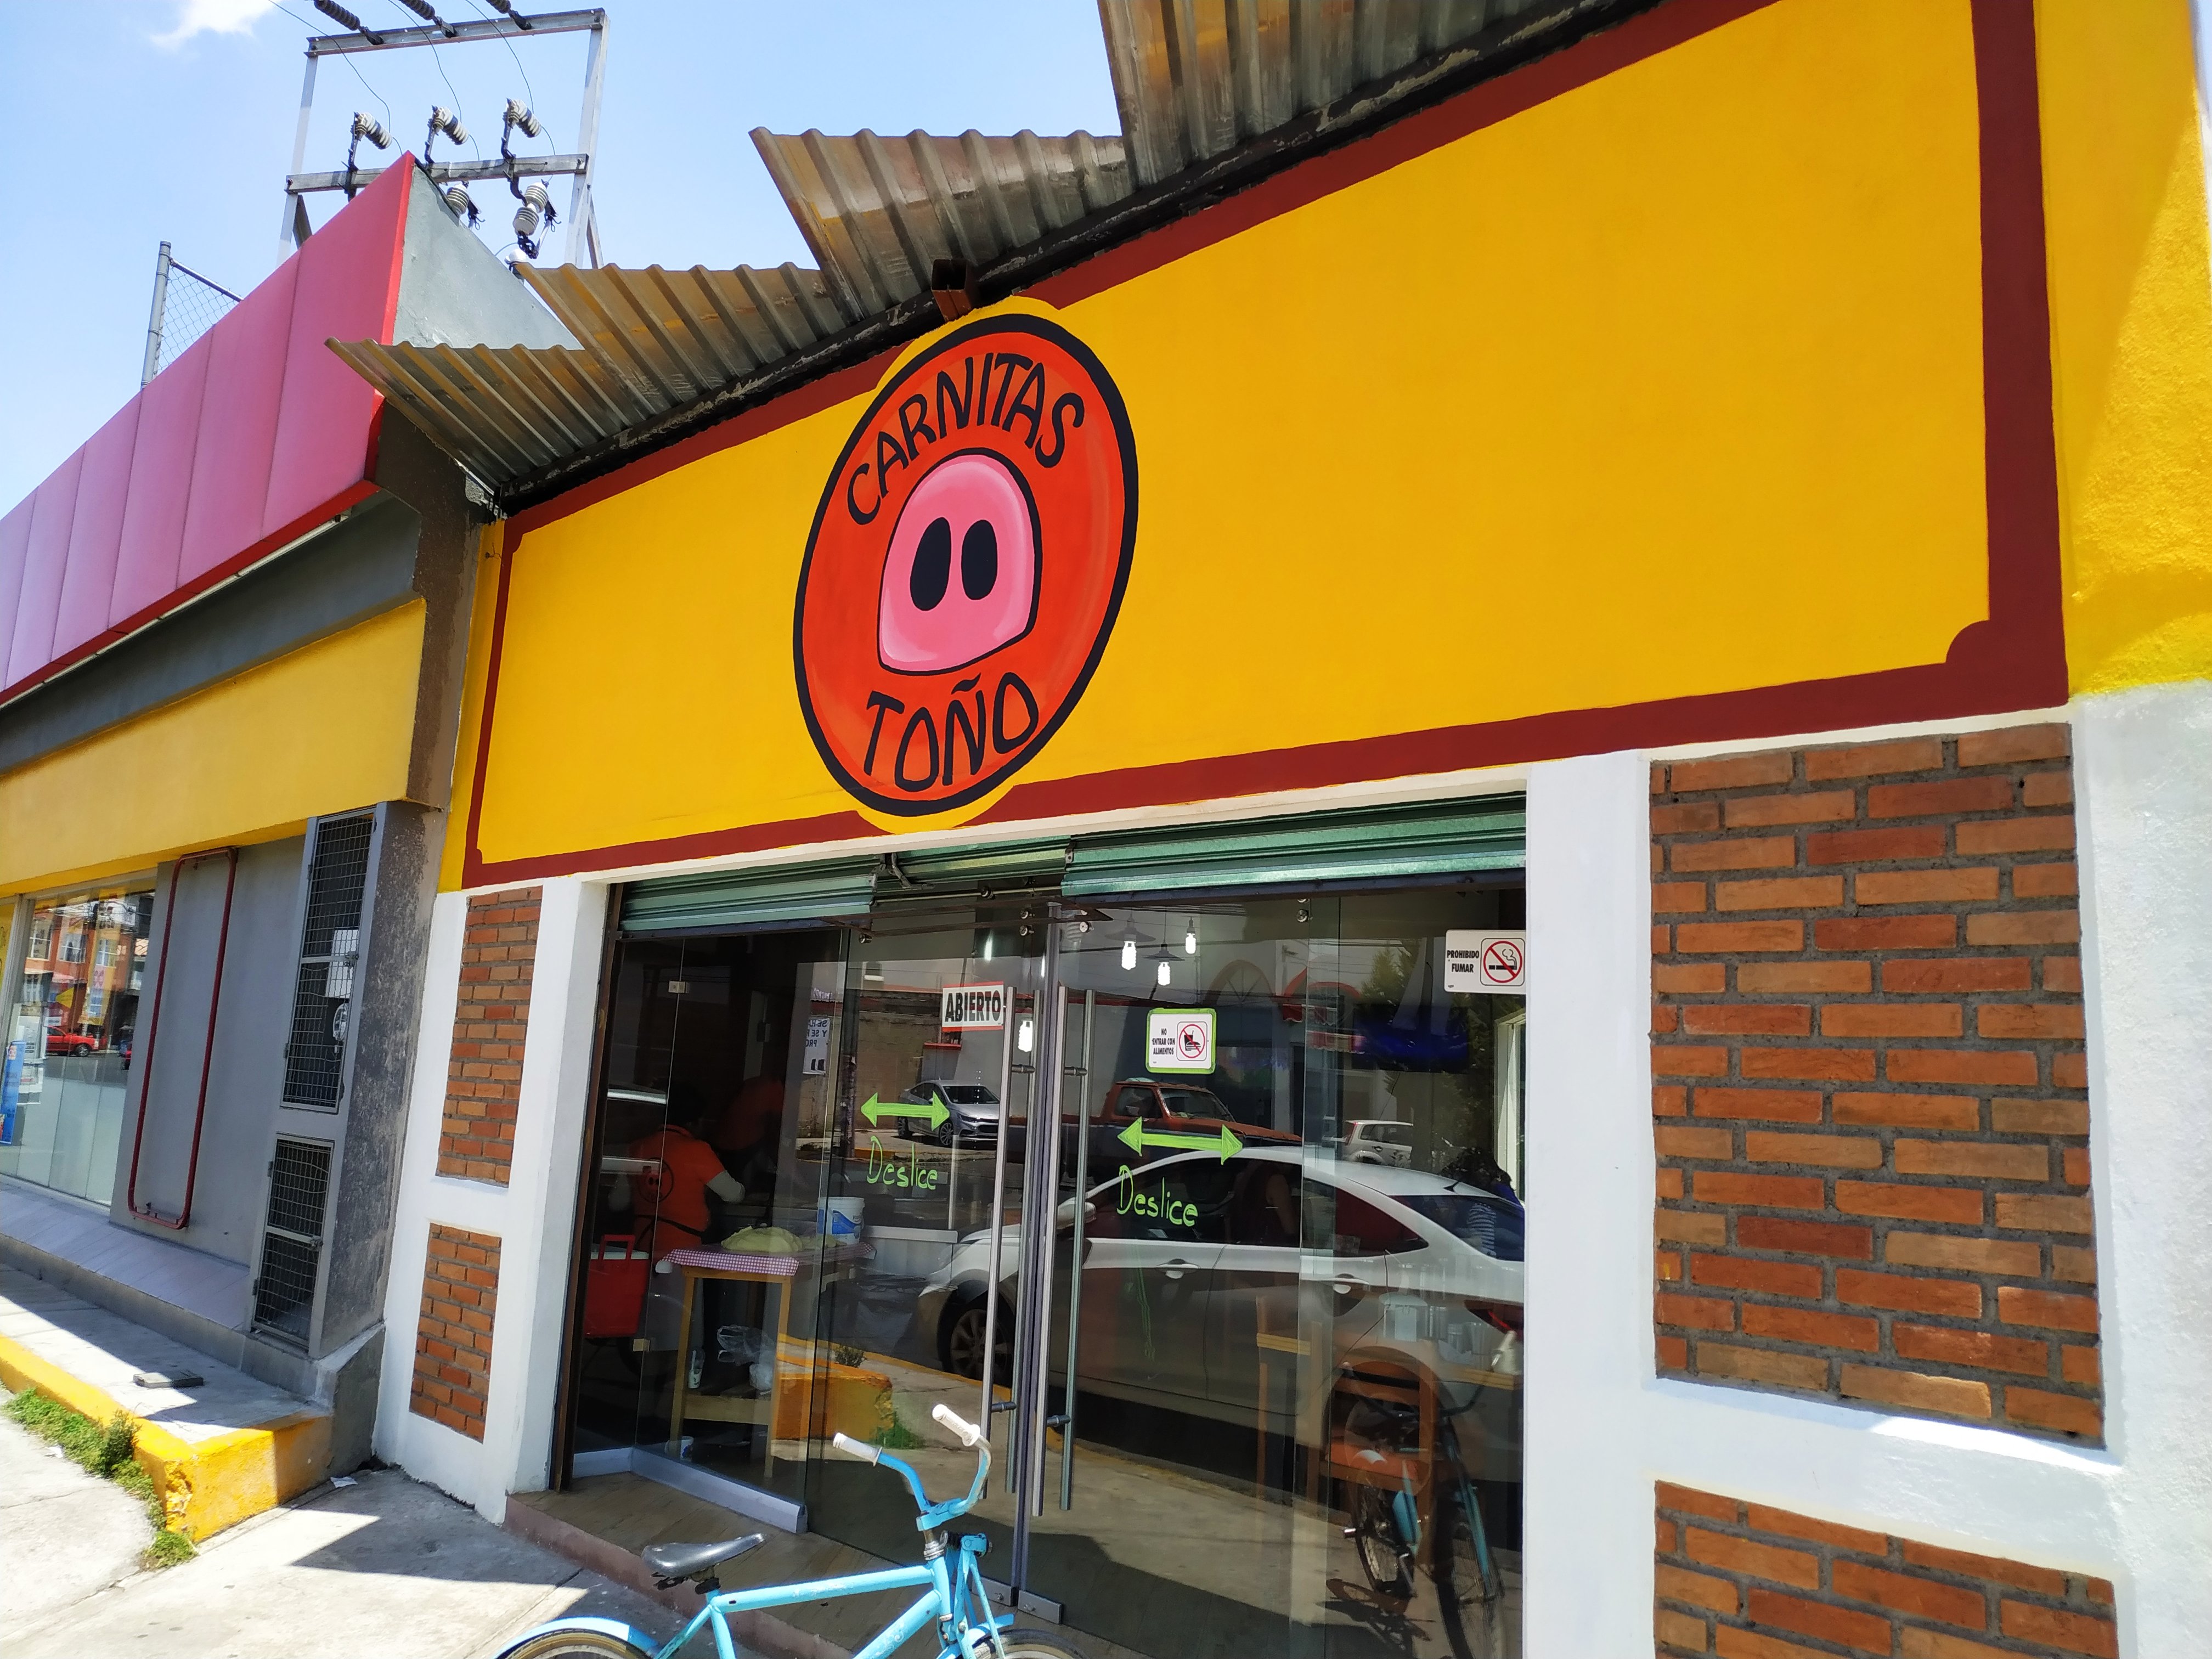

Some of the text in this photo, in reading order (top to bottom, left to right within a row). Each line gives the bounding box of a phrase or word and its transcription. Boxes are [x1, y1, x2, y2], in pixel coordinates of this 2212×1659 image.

[847, 352, 1085, 525] CARNITAS
[864, 672, 1039, 792] TOÑO
[1447, 950, 1480, 958] PROHIBIDO
[1452, 963, 1474, 973] FUMAR
[945, 990, 1001, 1022] ABIERTO
[867, 1136, 938, 1190] Deslice
[1116, 1165, 1198, 1227] Deslice
